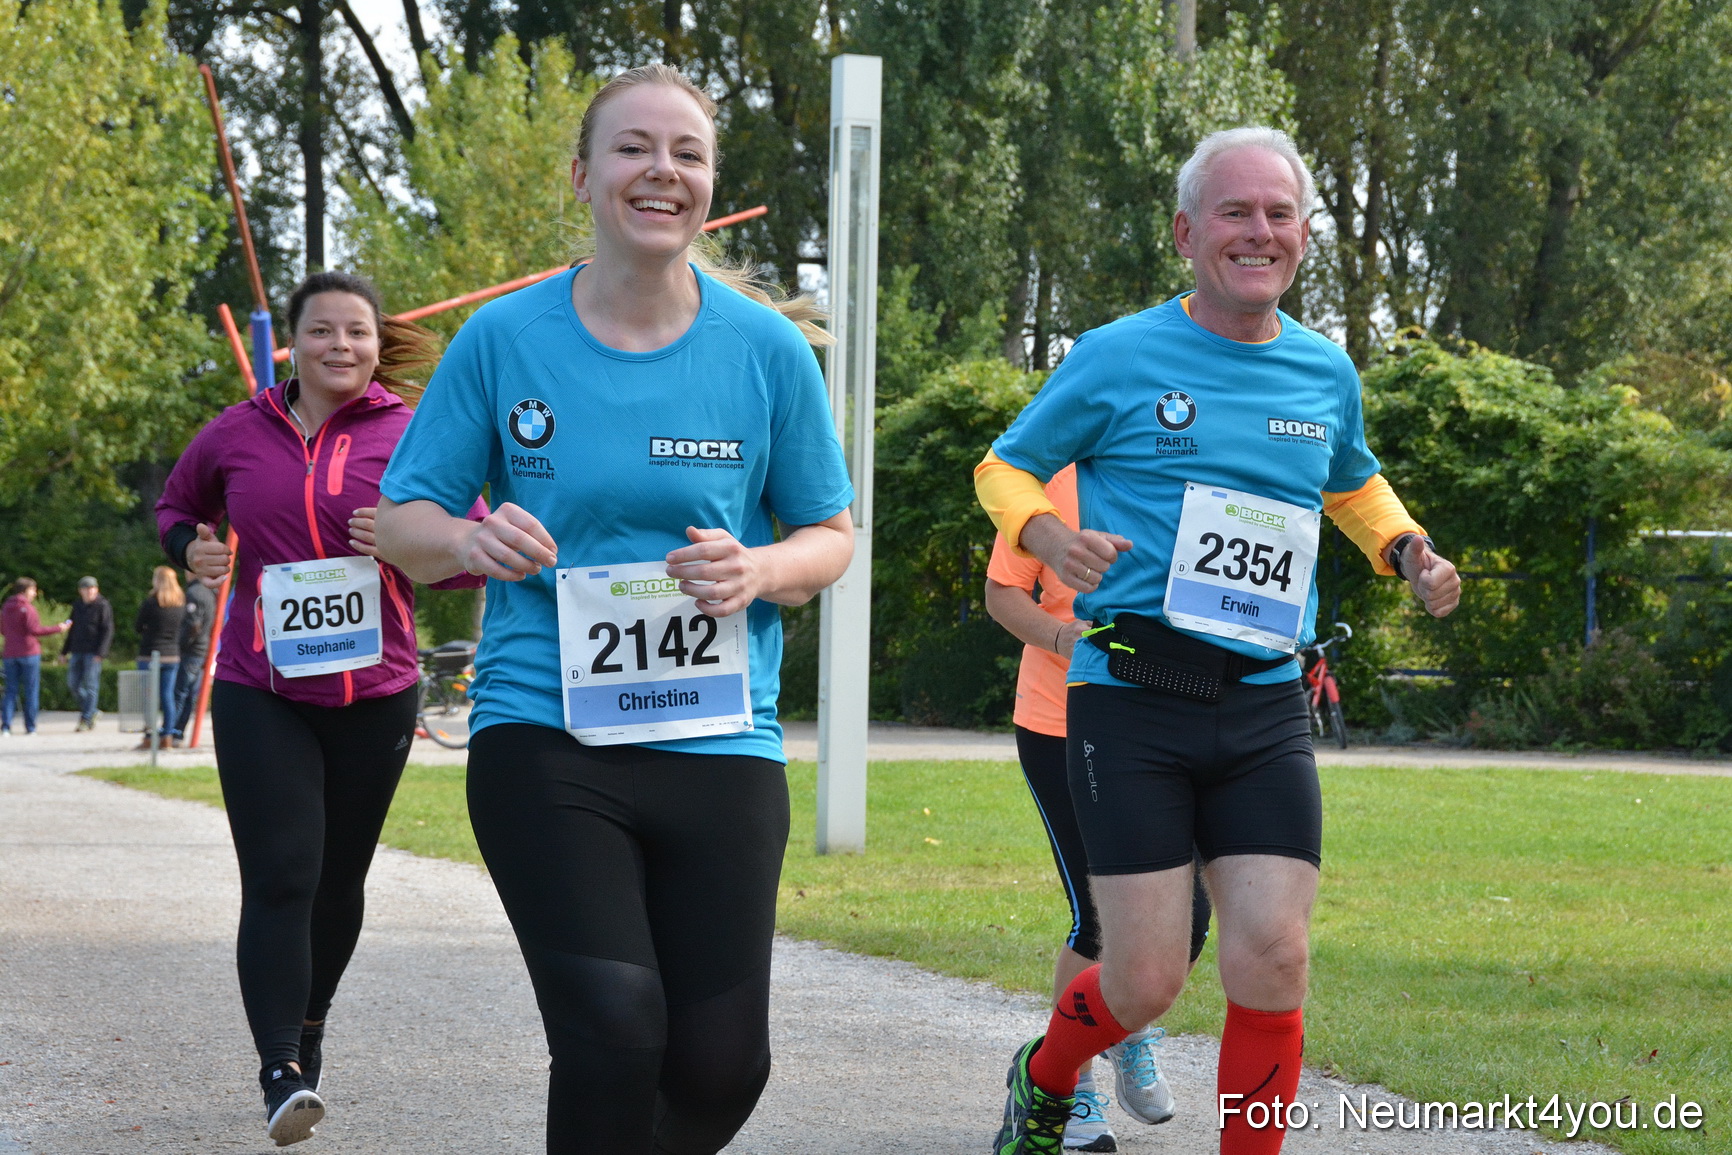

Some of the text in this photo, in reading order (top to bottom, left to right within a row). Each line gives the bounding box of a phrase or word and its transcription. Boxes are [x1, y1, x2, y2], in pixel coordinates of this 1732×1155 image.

[1159, 392, 1194, 406] BMW
[513, 400, 552, 418] BMW
[1268, 418, 1327, 442] BOCK
[1268, 435, 1291, 443] inspired
[650, 437, 744, 461] BOCK
[1156, 436, 1198, 448] PARTL
[1156, 447, 1198, 456] Neumarkt
[510, 454, 555, 471] PARTL
[649, 459, 680, 467] inspired
[681, 460, 691, 468] by
[512, 467, 555, 480] Neumarkt
[1240, 506, 1286, 528] BOCK
[1178, 563, 1185, 572] D
[1194, 532, 1293, 593] 2354
[304, 568, 347, 582] BOCK
[280, 591, 364, 632] 2650
[1221, 595, 1260, 618] Erwin
[297, 638, 356, 656] Stephanie
[588, 614, 720, 674] 2142
[571, 669, 579, 679] D
[618, 688, 700, 712] Christina
[1086, 758, 1098, 802] odlo
